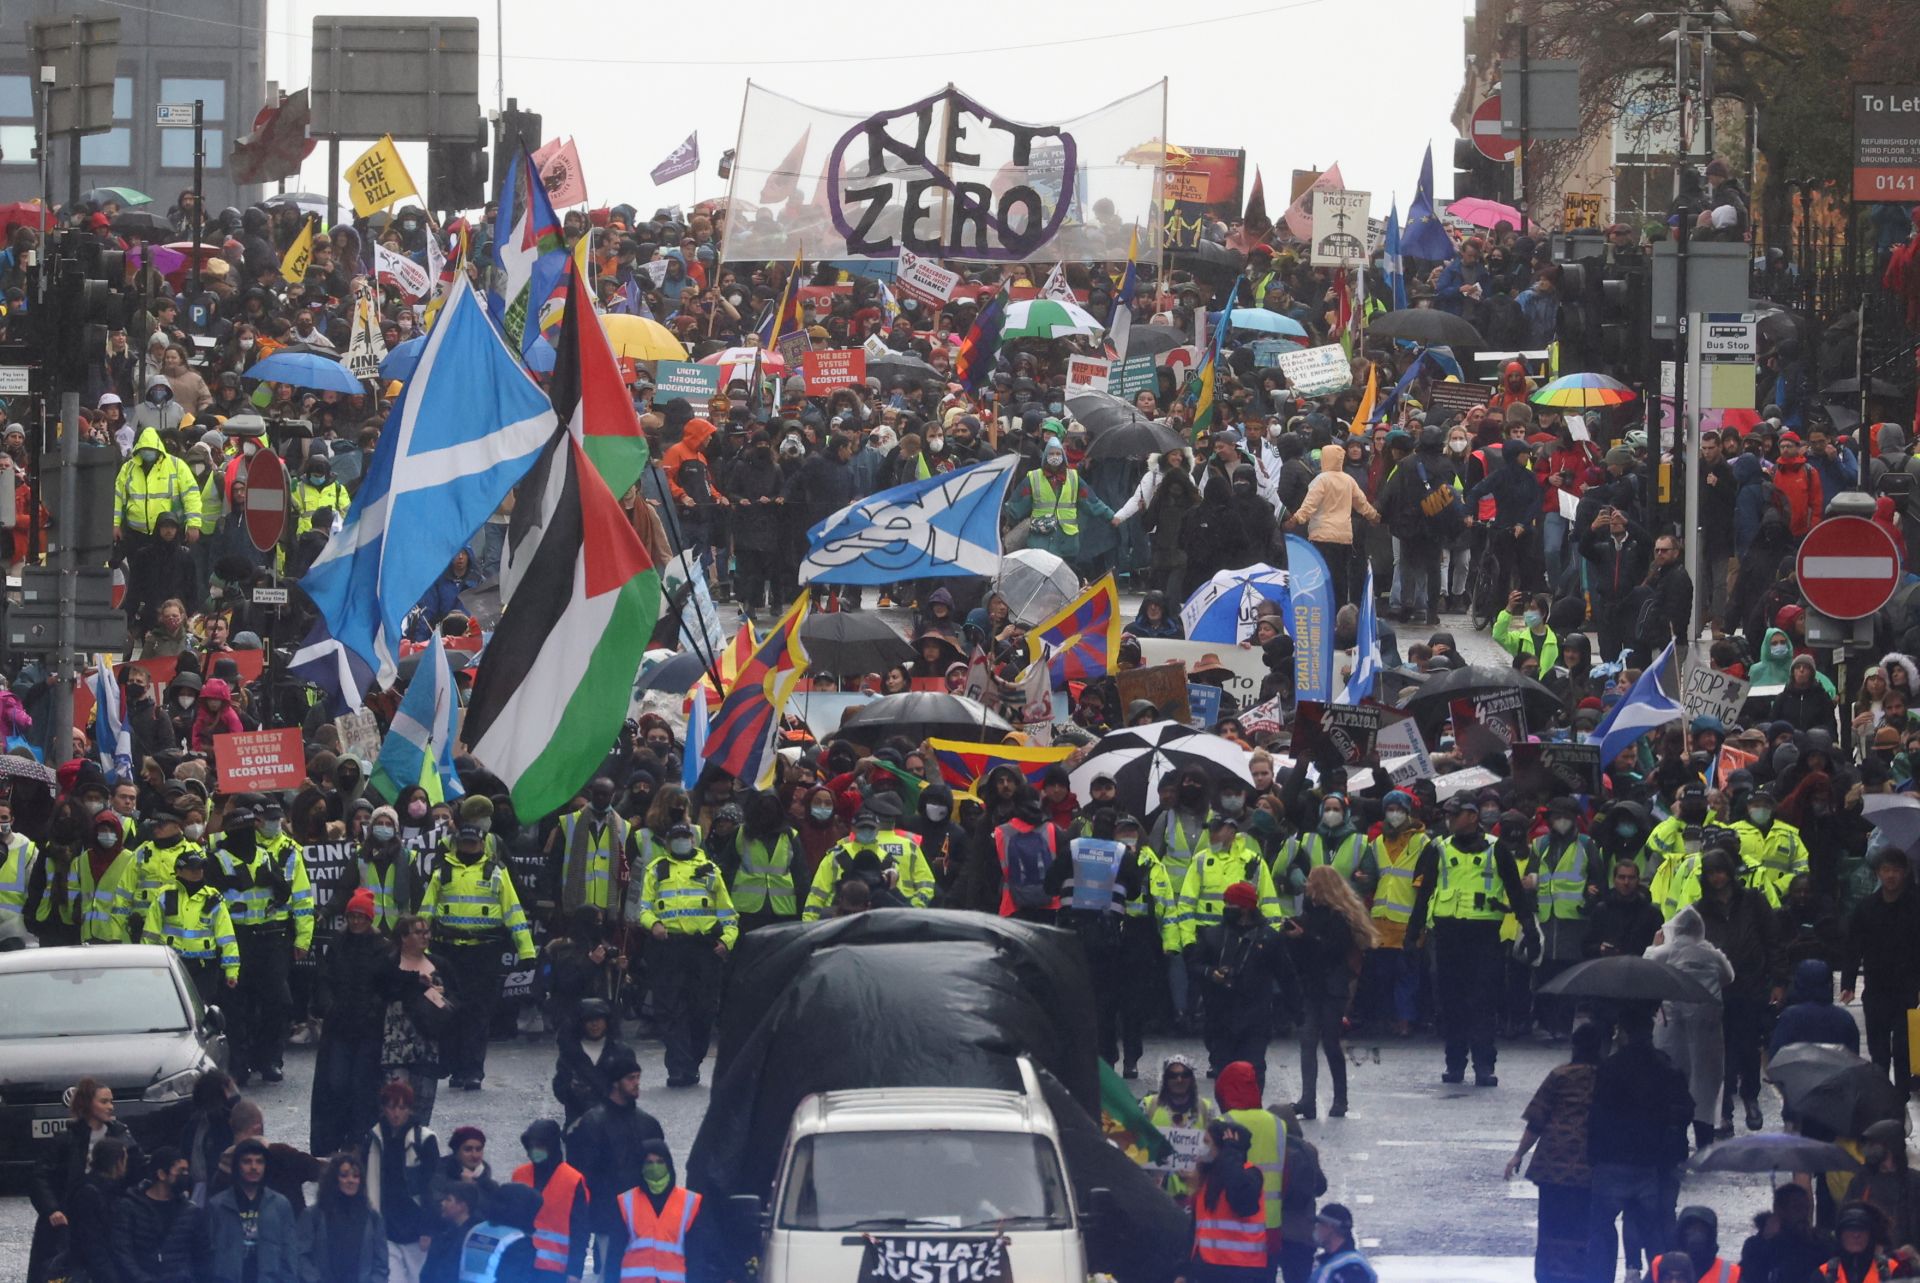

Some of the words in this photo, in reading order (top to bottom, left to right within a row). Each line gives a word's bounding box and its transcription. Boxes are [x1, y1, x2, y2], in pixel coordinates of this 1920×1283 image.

[1862, 95, 1884, 112] To
[1890, 95, 1920, 112] Let
[865, 96, 1061, 177] NET
[356, 151, 386, 177] KILL
[358, 166, 385, 189] THE
[1876, 175, 1914, 190] 0141
[365, 182, 396, 205] BILL
[1323, 196, 1364, 208] PROTECT
[1566, 194, 1600, 213] Hungry
[845, 178, 1044, 256] ZERO
[1330, 234, 1352, 242] WATER
[1323, 245, 1335, 256] NO
[919, 264, 951, 282] GRASSROOTS
[913, 274, 946, 293] ALLIANCE
[193, 306, 204, 323] P
[1706, 341, 1724, 349] Bus
[1727, 341, 1750, 350] Stop
[816, 352, 832, 360] THE
[833, 352, 852, 360] BEST
[818, 360, 850, 368] SYSTEM
[811, 375, 858, 384] ECOSYSTEM
[830, 368, 848, 376] OUR
[668, 375, 708, 386] THROUGH
[1688, 668, 1725, 695] STOP
[1320, 710, 1334, 732] 4
[1475, 702, 1487, 725] 4
[232, 735, 254, 746] THE
[255, 732, 283, 743] BEST
[236, 744, 281, 755] SYSTEM
[242, 756, 253, 766] IS
[255, 755, 279, 764] OUR
[228, 763, 294, 777] ECOSYSTEM
[872, 1258, 1002, 1283] JUSTICE
